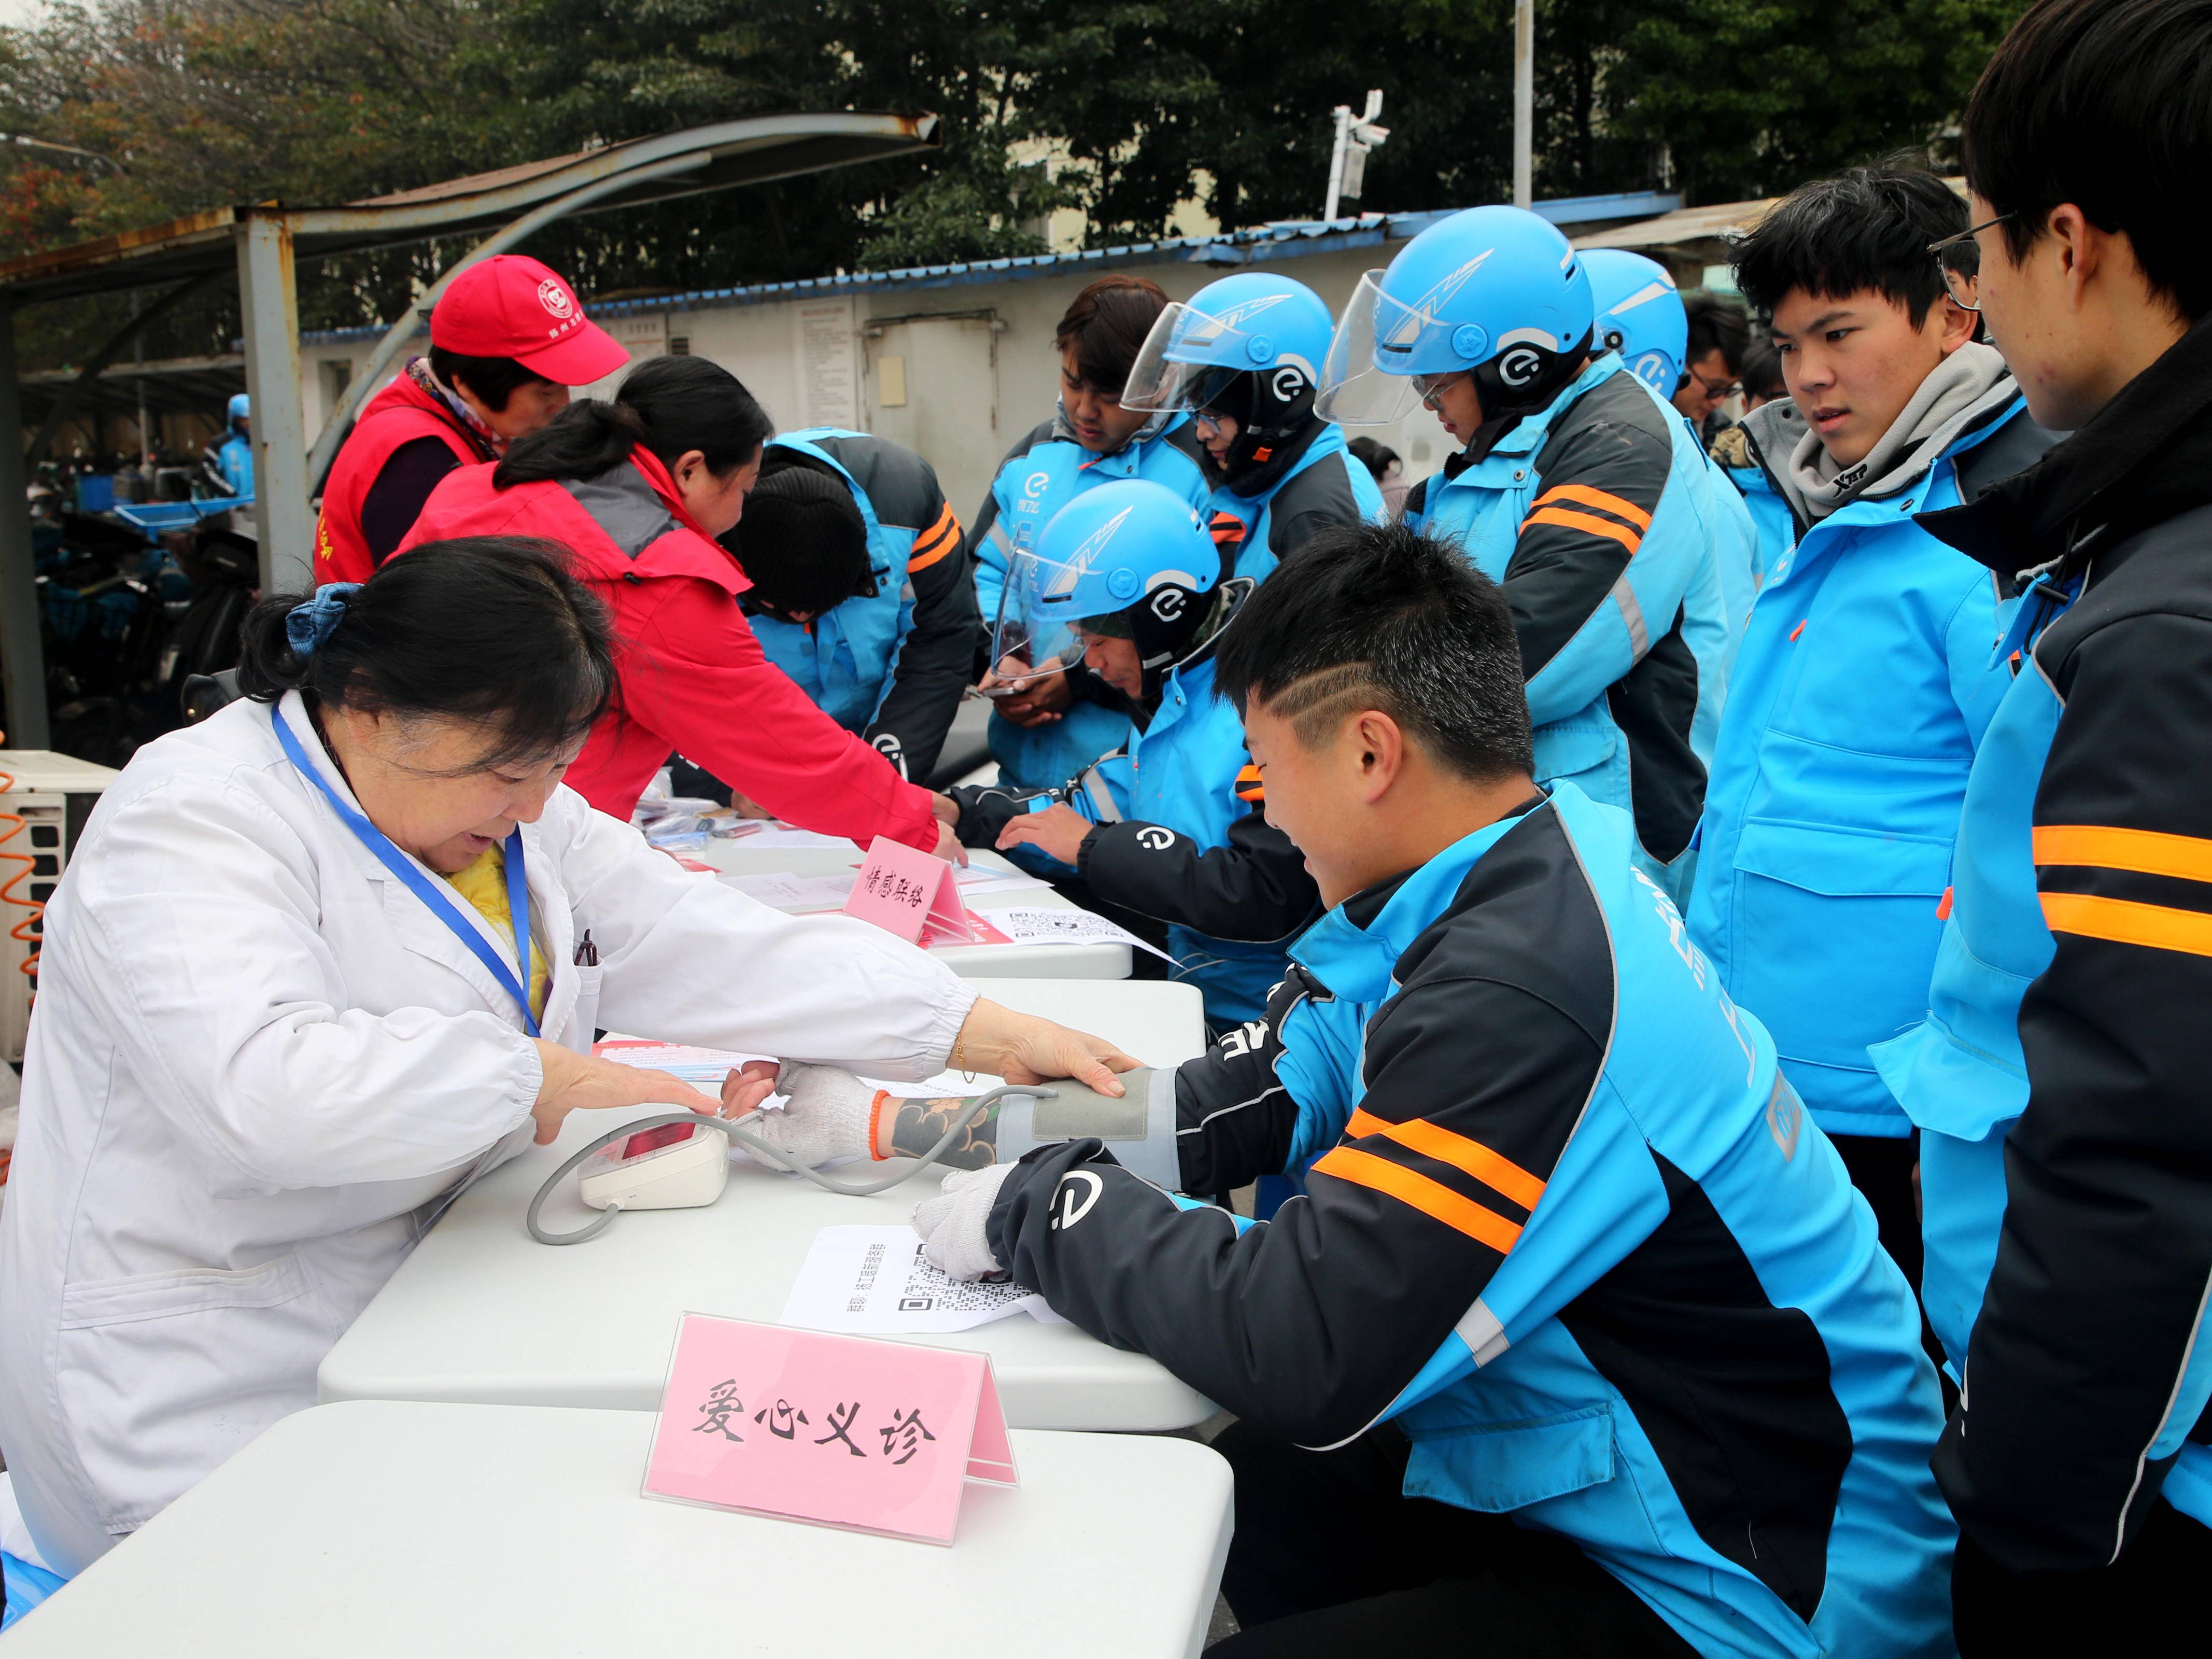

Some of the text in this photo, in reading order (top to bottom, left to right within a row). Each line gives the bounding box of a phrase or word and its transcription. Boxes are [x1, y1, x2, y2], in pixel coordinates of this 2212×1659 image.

[1833, 463, 1868, 498] XTEP
[864, 865, 923, 907] 情感联络
[692, 1379, 936, 1465] 爱心义诊
